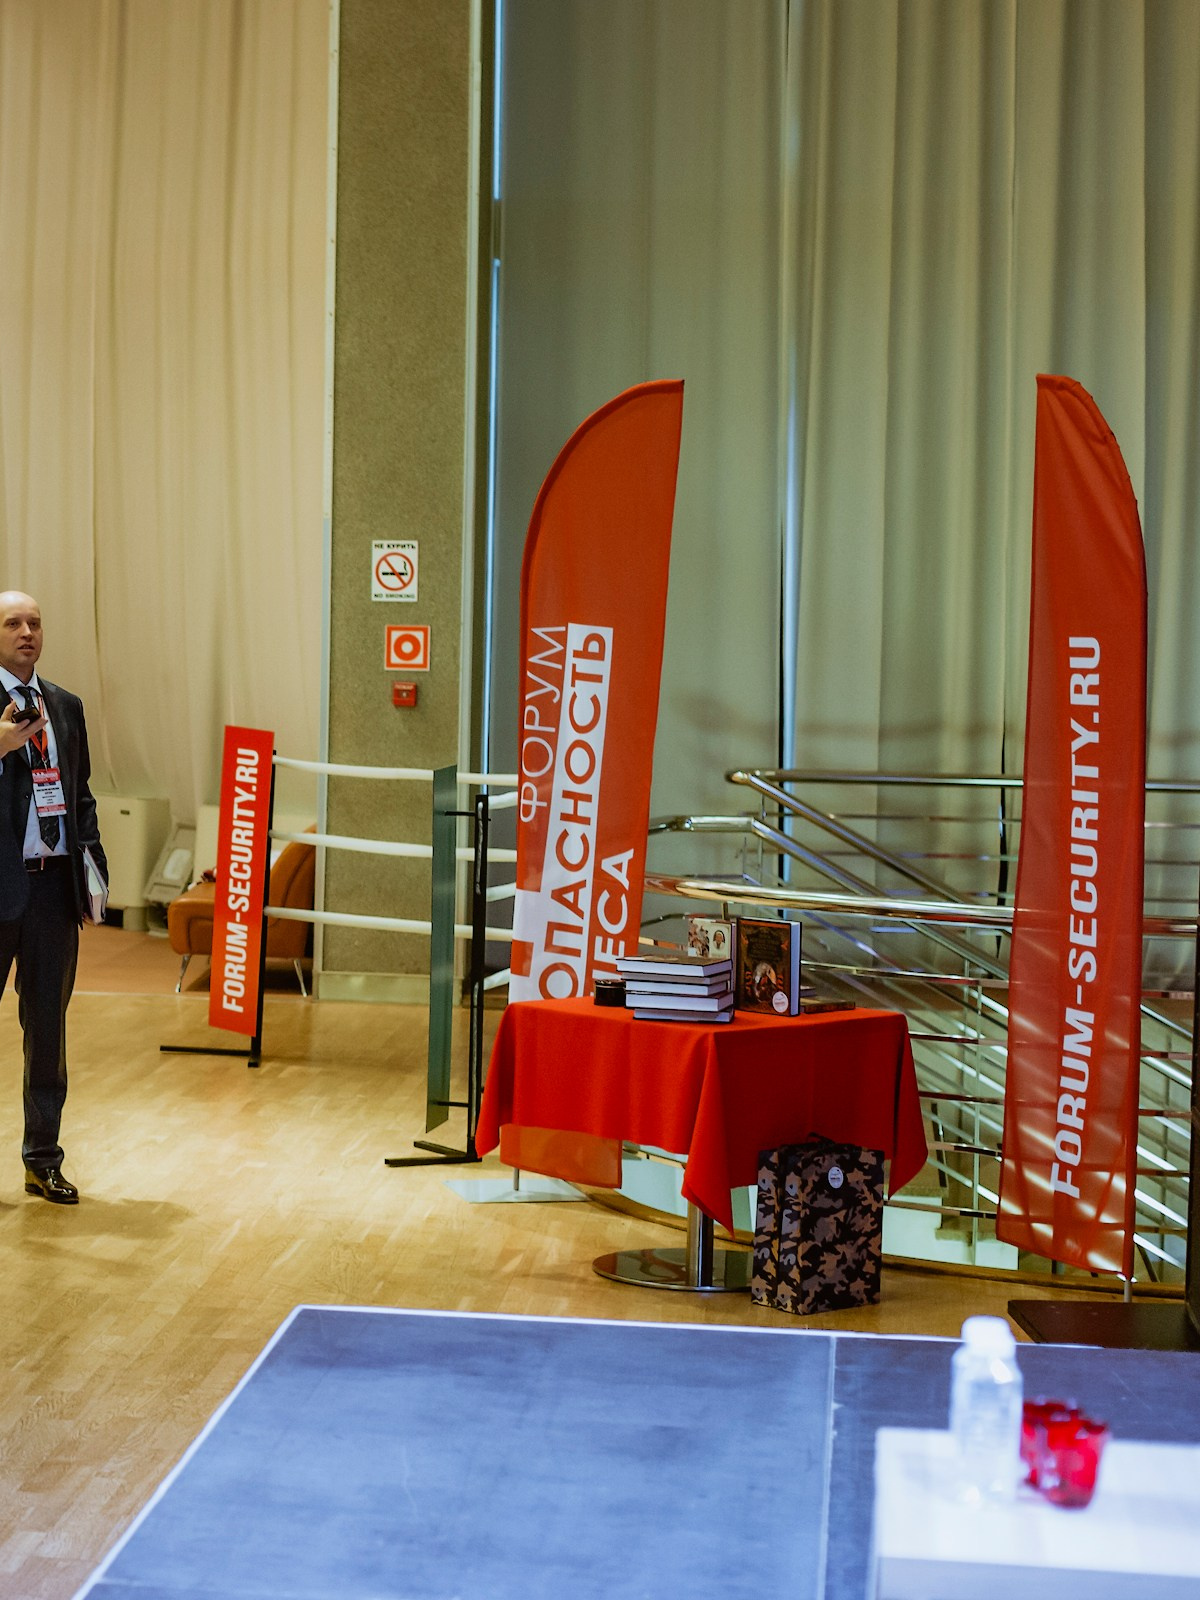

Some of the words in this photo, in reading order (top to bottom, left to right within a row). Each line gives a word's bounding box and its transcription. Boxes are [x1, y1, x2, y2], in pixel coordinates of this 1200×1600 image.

[222, 748, 259, 1013] FORUM-SECURITY.RU
[519, 625, 566, 823] ФОРУМ
[537, 631, 607, 1000] ОПАСНОСТЬ
[1051, 636, 1101, 1199] FORUM-SECURITY.RU
